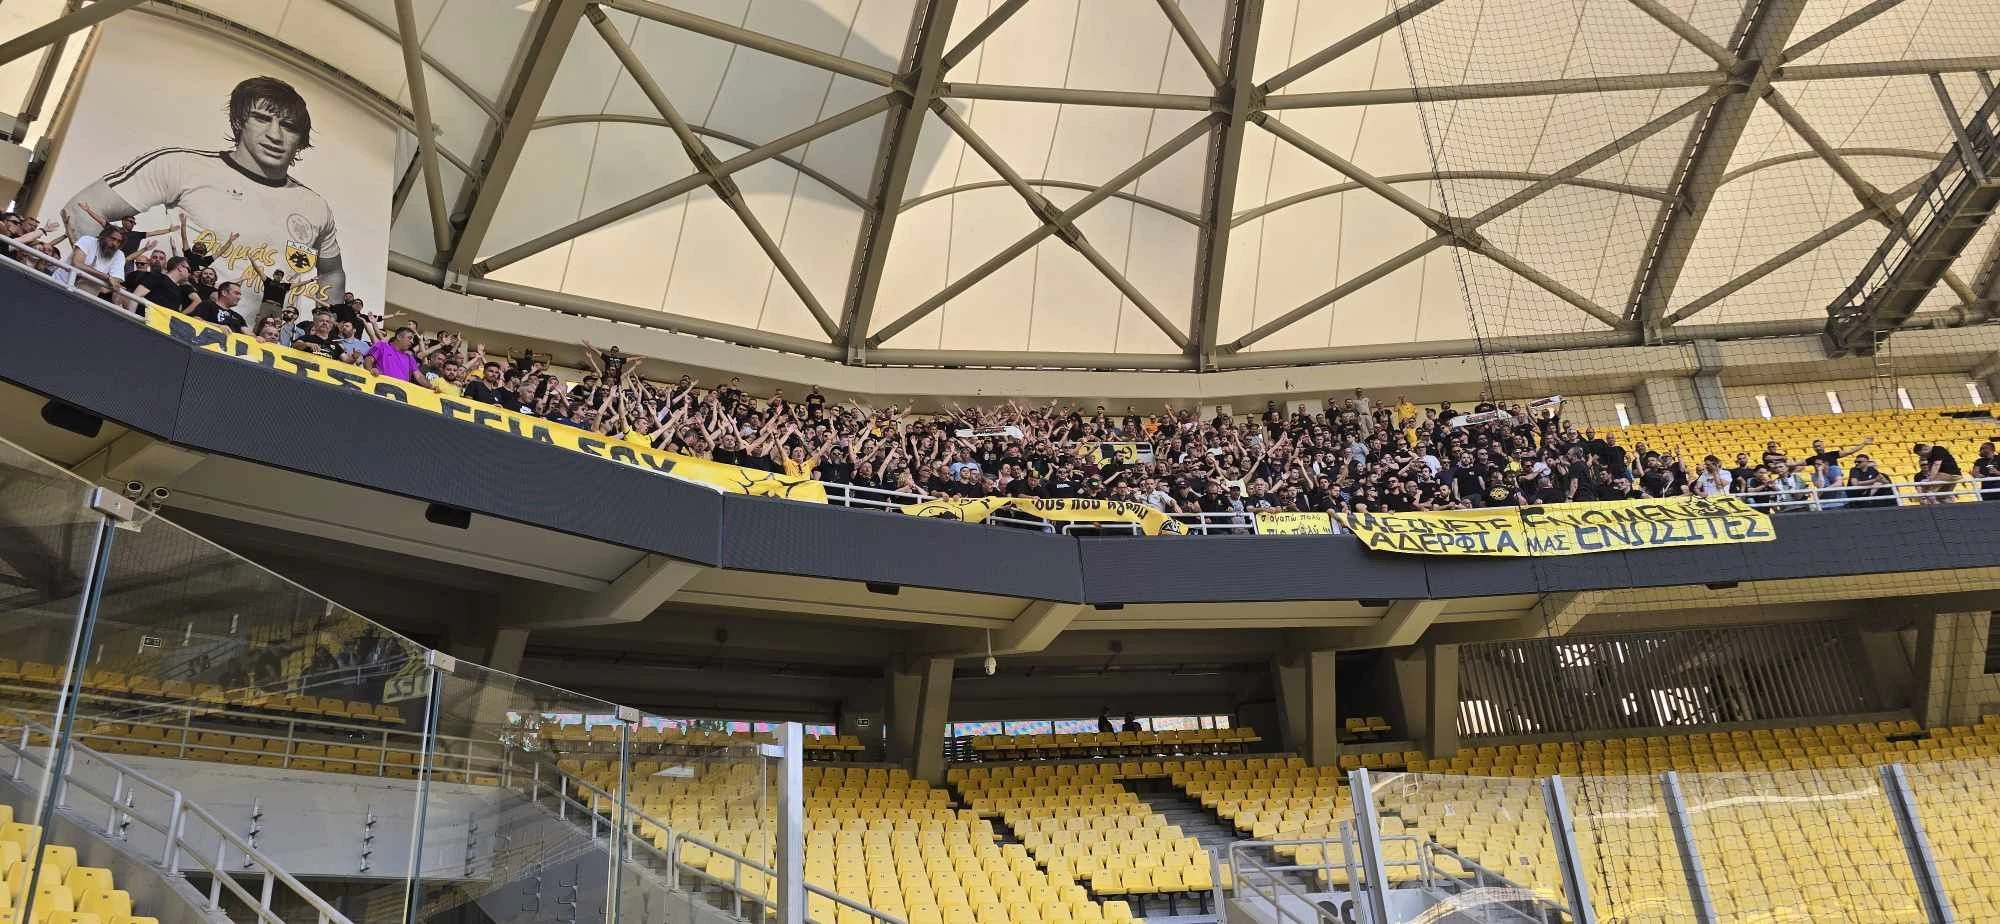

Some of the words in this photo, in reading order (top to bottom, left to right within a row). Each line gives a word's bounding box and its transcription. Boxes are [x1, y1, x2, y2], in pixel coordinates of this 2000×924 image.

[1347, 511, 1512, 534] ΜΕΙΝΕΤΕ
[1370, 530, 1520, 553] ΑΔΕΡΦΙΑ
[1527, 534, 1571, 552] ΜΑΣ
[1574, 515, 1770, 551] ΕΝΩΣΙΤΕΣ
